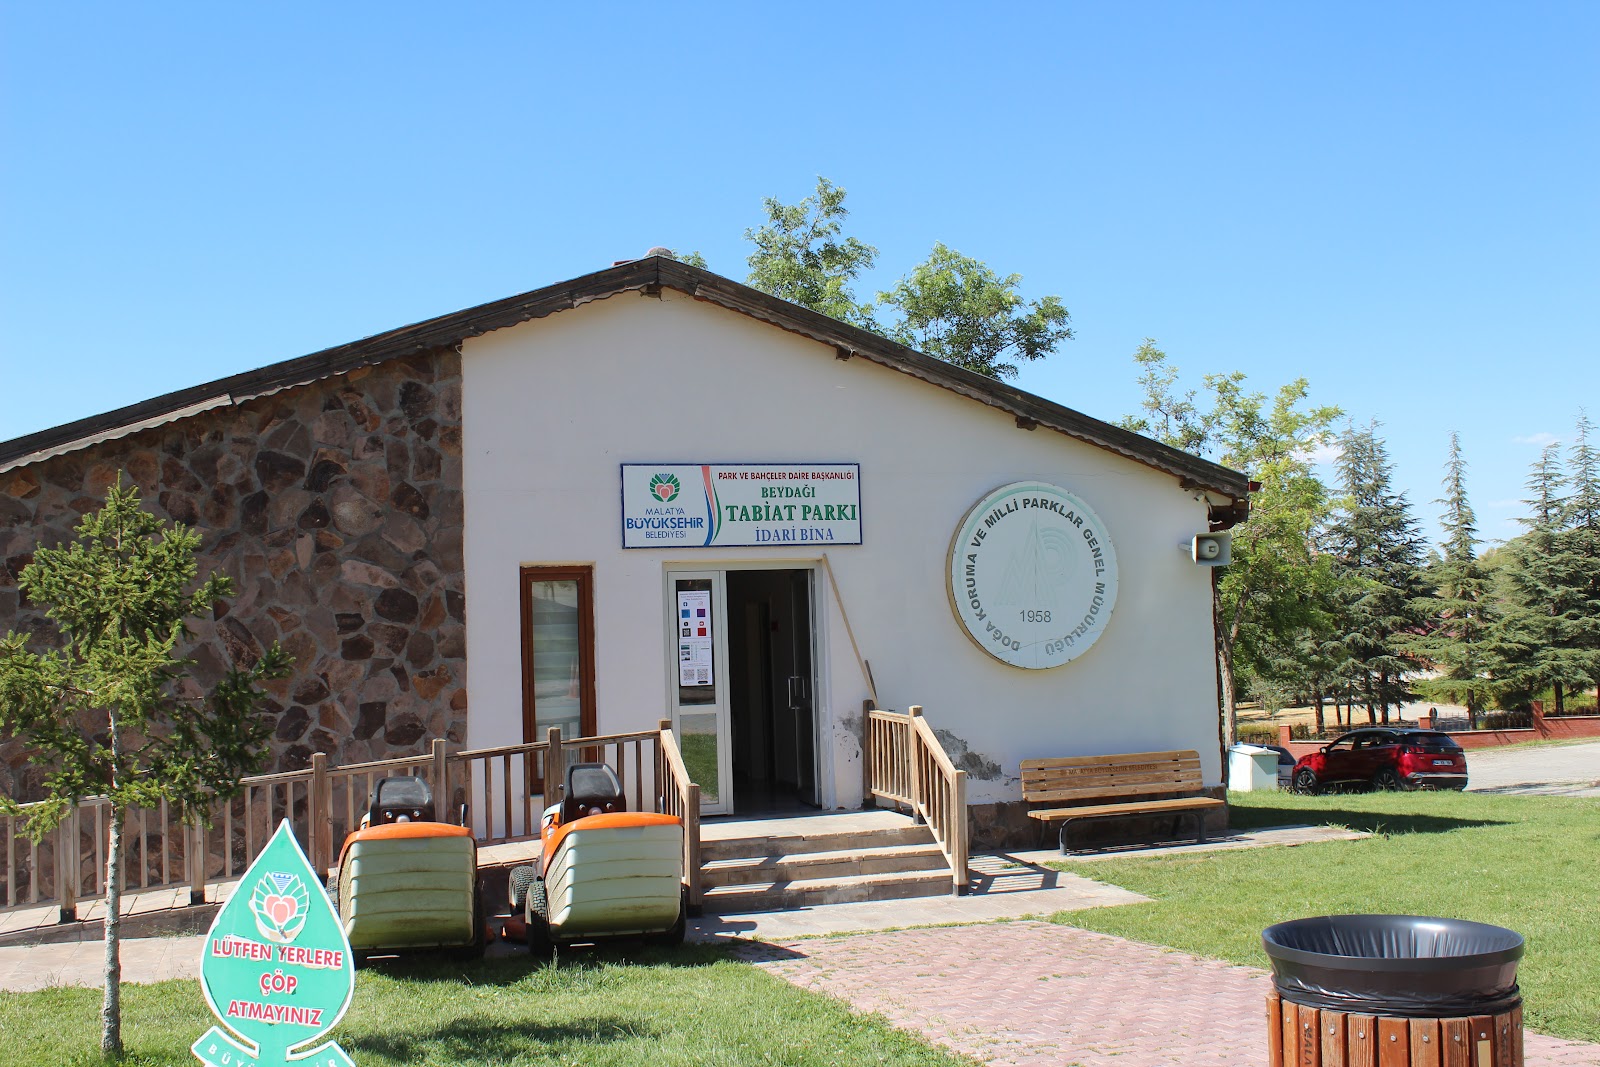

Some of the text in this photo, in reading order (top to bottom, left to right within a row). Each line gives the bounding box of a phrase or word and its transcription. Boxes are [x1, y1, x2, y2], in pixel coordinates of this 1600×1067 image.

[718, 470, 855, 482] PARK VE BAHÇELER DAİRE BAŞKANLIĞI
[761, 484, 816, 498] BEYDAĞI
[645, 507, 685, 515] MALATYA
[725, 501, 857, 522] TABİAT PARKI
[626, 517, 704, 530] BÜYÜKŞEHİR
[755, 525, 834, 542] İDARİ BİNA
[965, 497, 1106, 656] DOĞA KORUMA VE MİLLİ PARKLAR GENEL MÜDÜRLÜĞÜ
[1019, 610, 1052, 623] 1958
[212, 936, 342, 967] LÜTFEN YERLERE
[260, 969, 297, 995] ÇÖP
[227, 1000, 323, 1026] ATMAYINIZ
